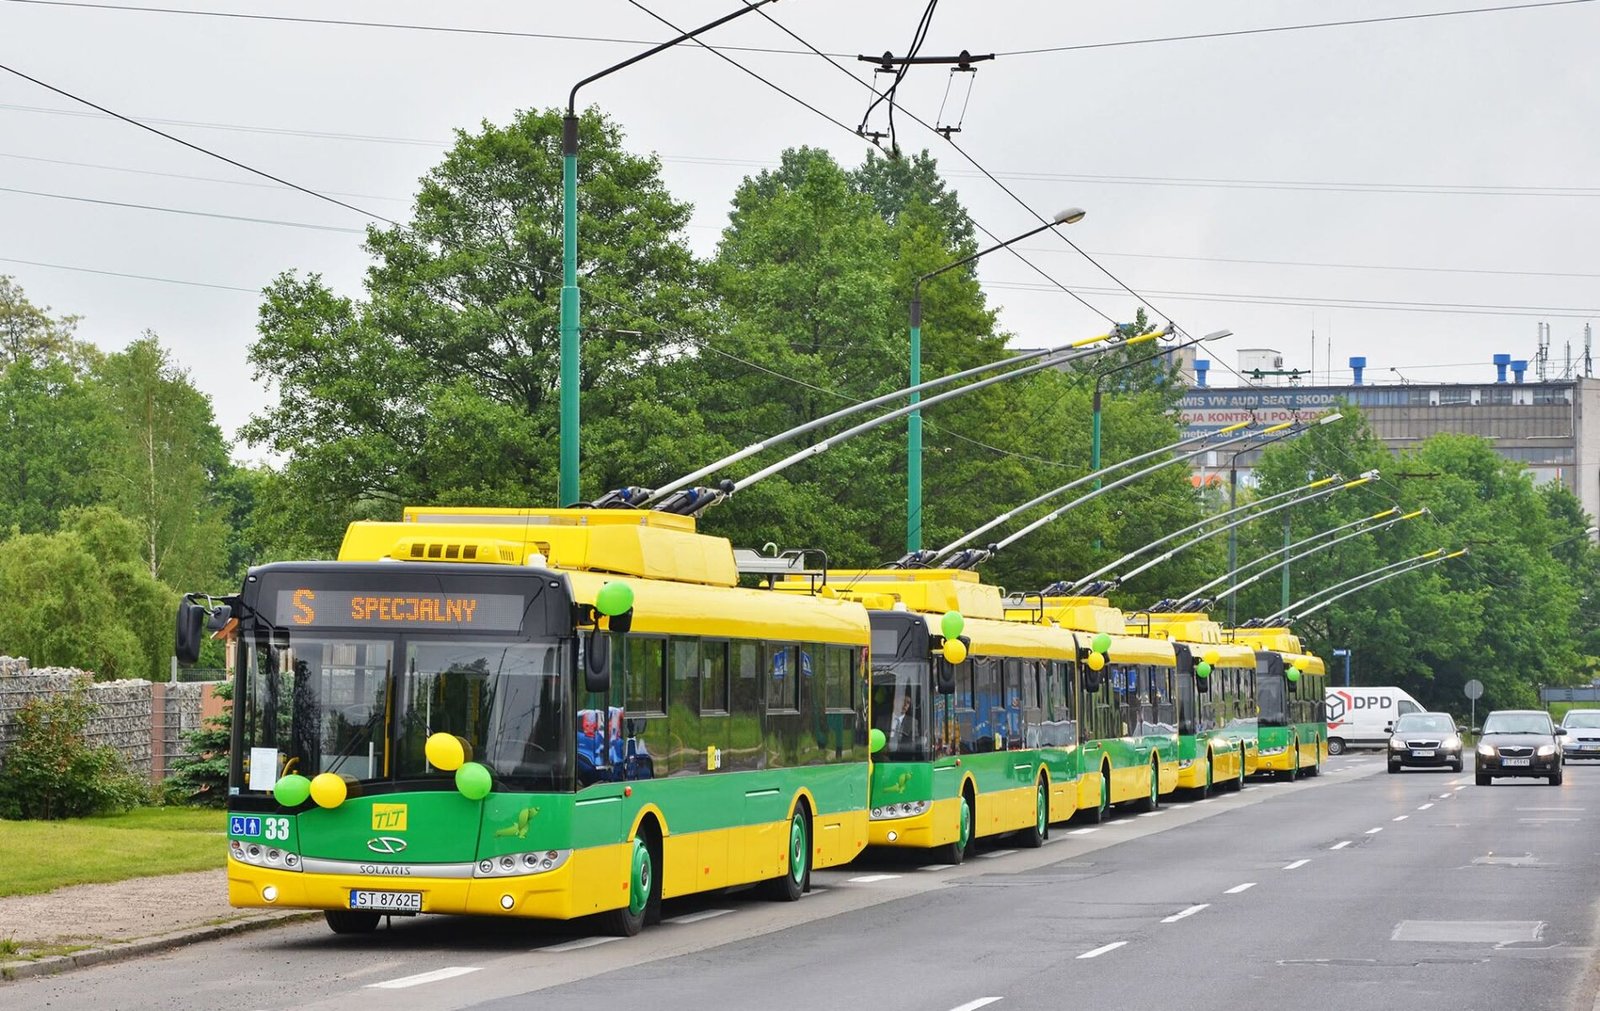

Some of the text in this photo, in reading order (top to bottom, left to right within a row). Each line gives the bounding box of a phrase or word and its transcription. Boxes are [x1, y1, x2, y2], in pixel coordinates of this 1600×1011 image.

[1171, 394, 1335, 407] RWIS VW AUDI SEAT SKODA
[1178, 412, 1205, 422] CJA
[292, 588, 476, 625] S SPECJALNY
[1354, 696, 1392, 709] DPD
[375, 810, 405, 829] TLT
[265, 817, 290, 841] 33
[359, 864, 411, 875] SOLARIS
[358, 892, 419, 907] ST 8762E
